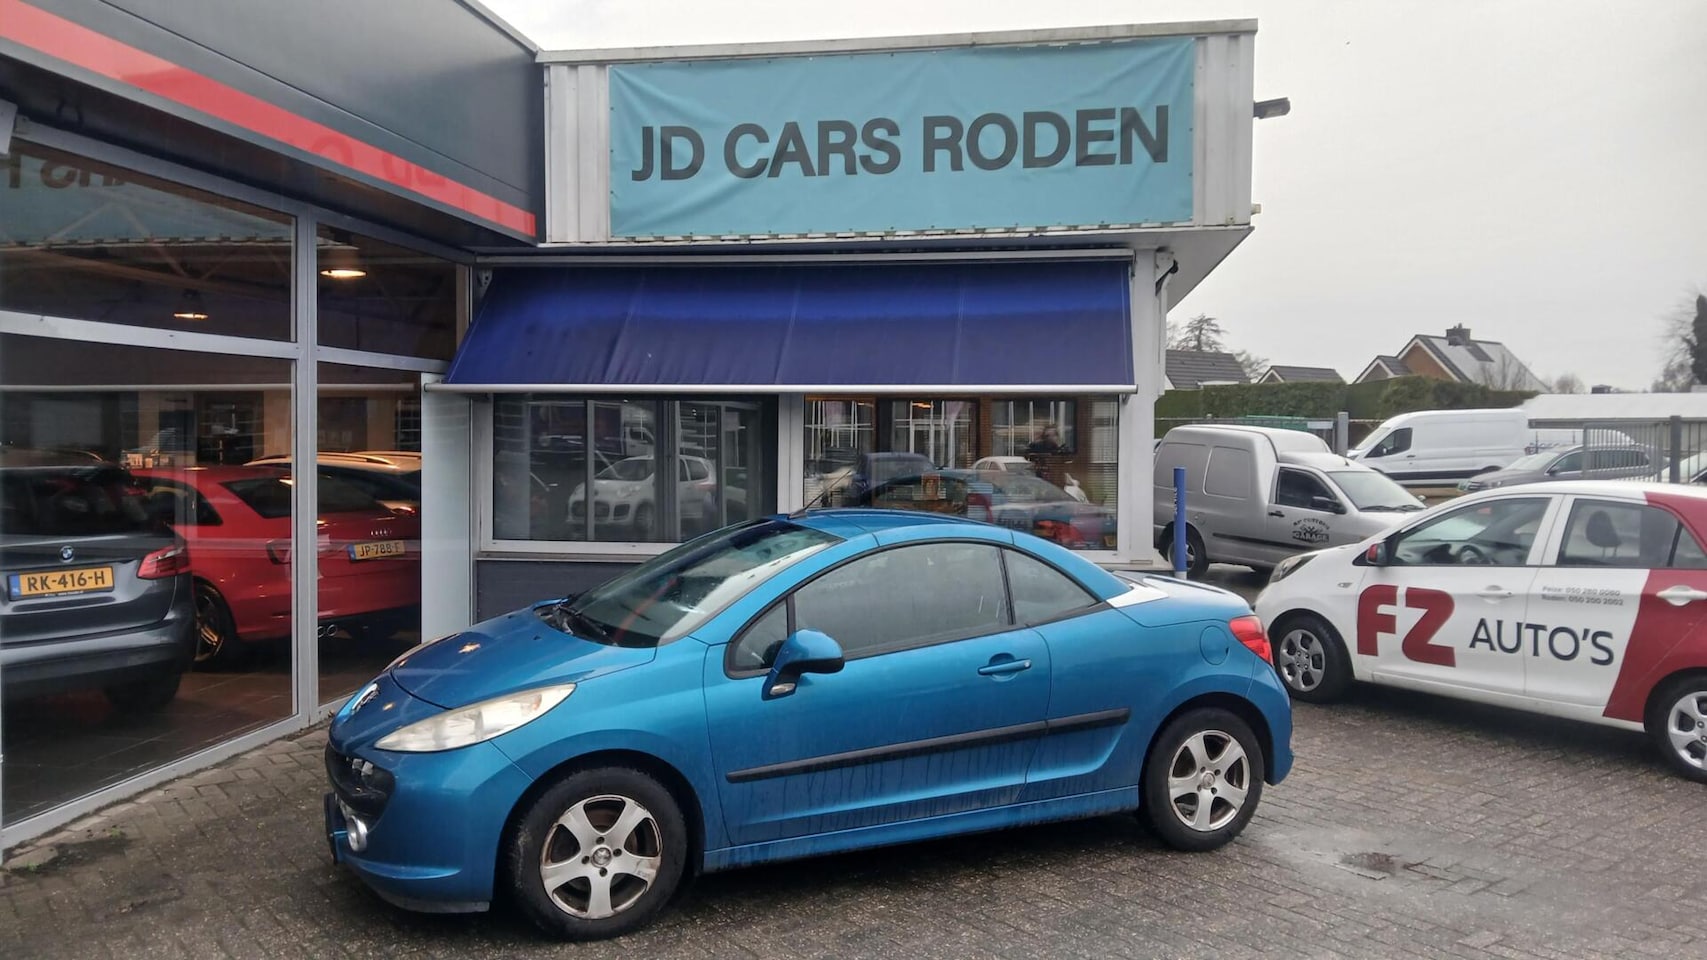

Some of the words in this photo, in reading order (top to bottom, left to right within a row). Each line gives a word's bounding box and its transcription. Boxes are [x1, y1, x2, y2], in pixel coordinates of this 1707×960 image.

[631, 125, 705, 182] JD
[723, 117, 901, 180] CARS
[922, 104, 1169, 173] RODEN
[27, 570, 106, 592] RK-416-H
[1568, 595, 1584, 603] 050
[1357, 584, 1456, 668] FZ
[1469, 617, 1615, 666] AUTO'S
